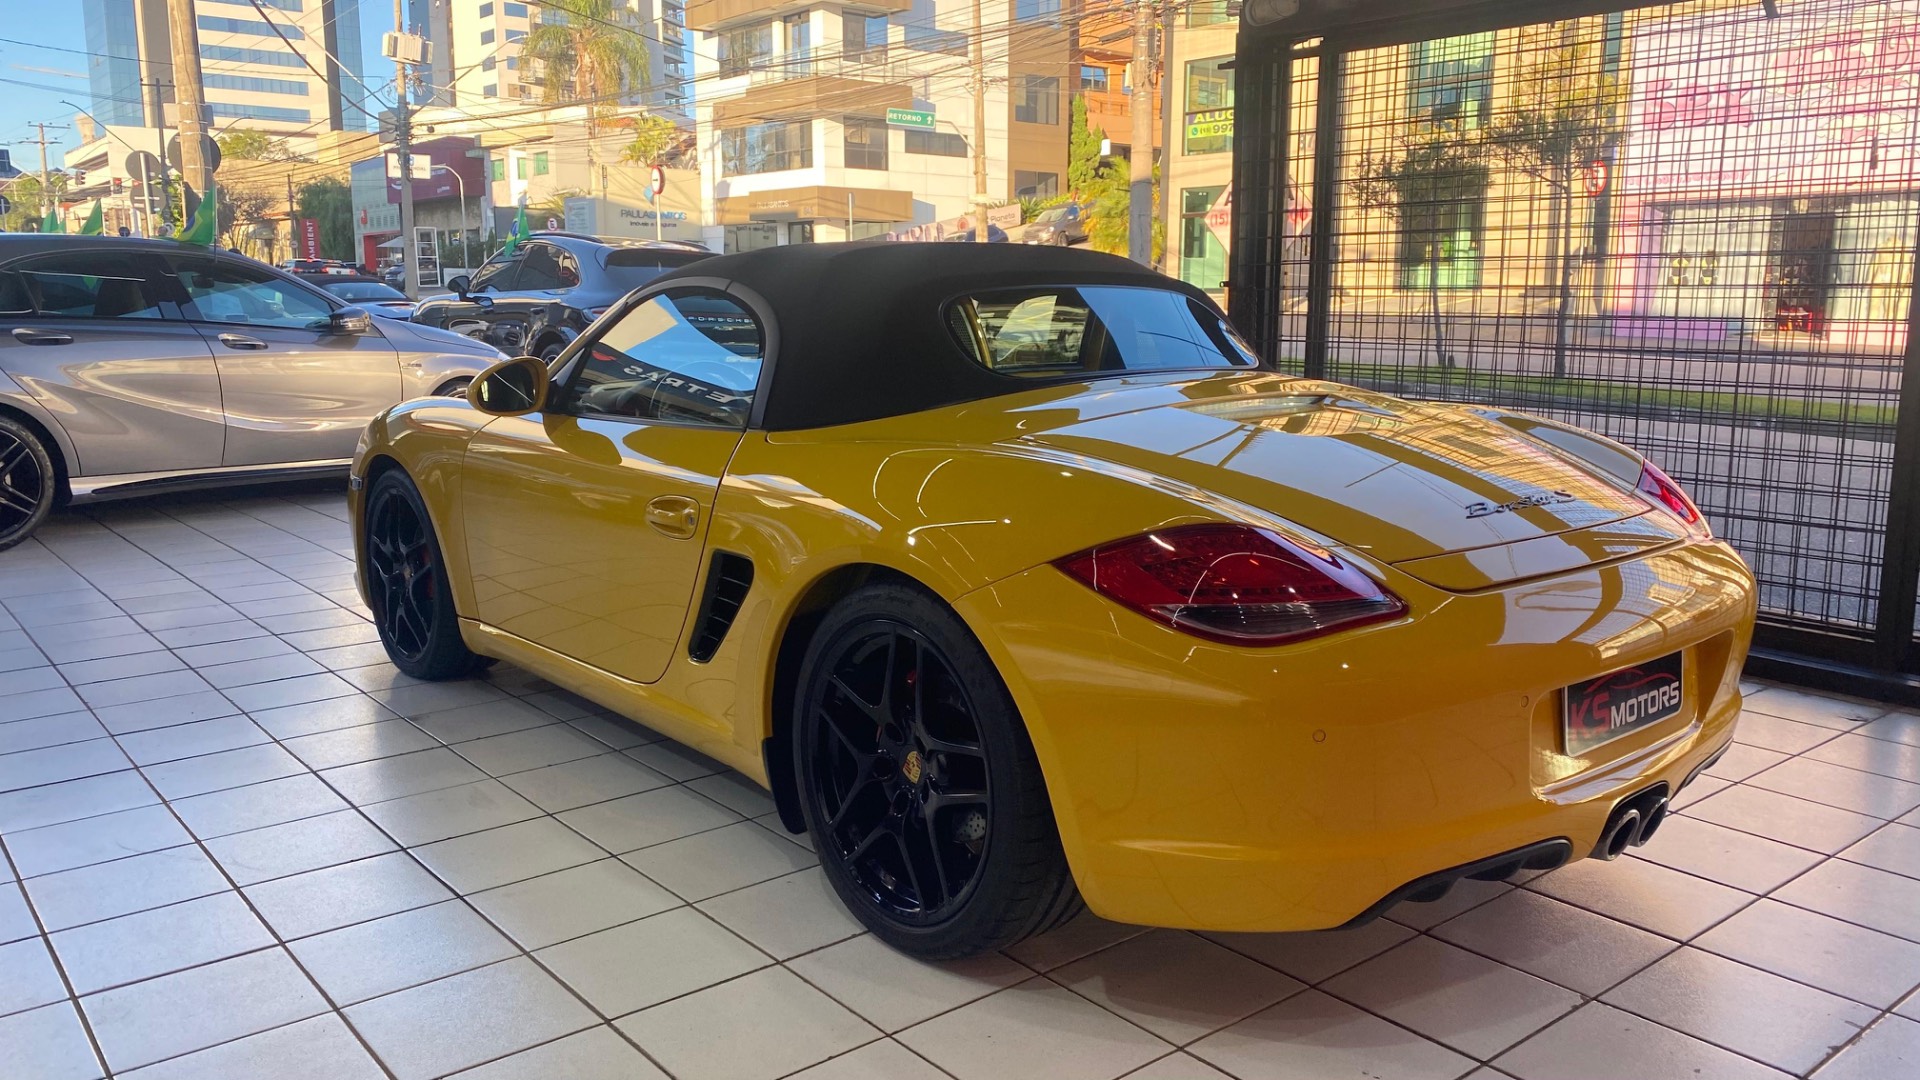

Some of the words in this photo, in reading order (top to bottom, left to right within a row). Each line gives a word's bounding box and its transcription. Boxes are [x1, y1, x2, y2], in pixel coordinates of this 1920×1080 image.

[889, 112, 922, 122] RETORNO
[1210, 211, 1229, 227] (15)
[1570, 690, 1610, 742] KS
[1610, 681, 1680, 730] MOTORS
